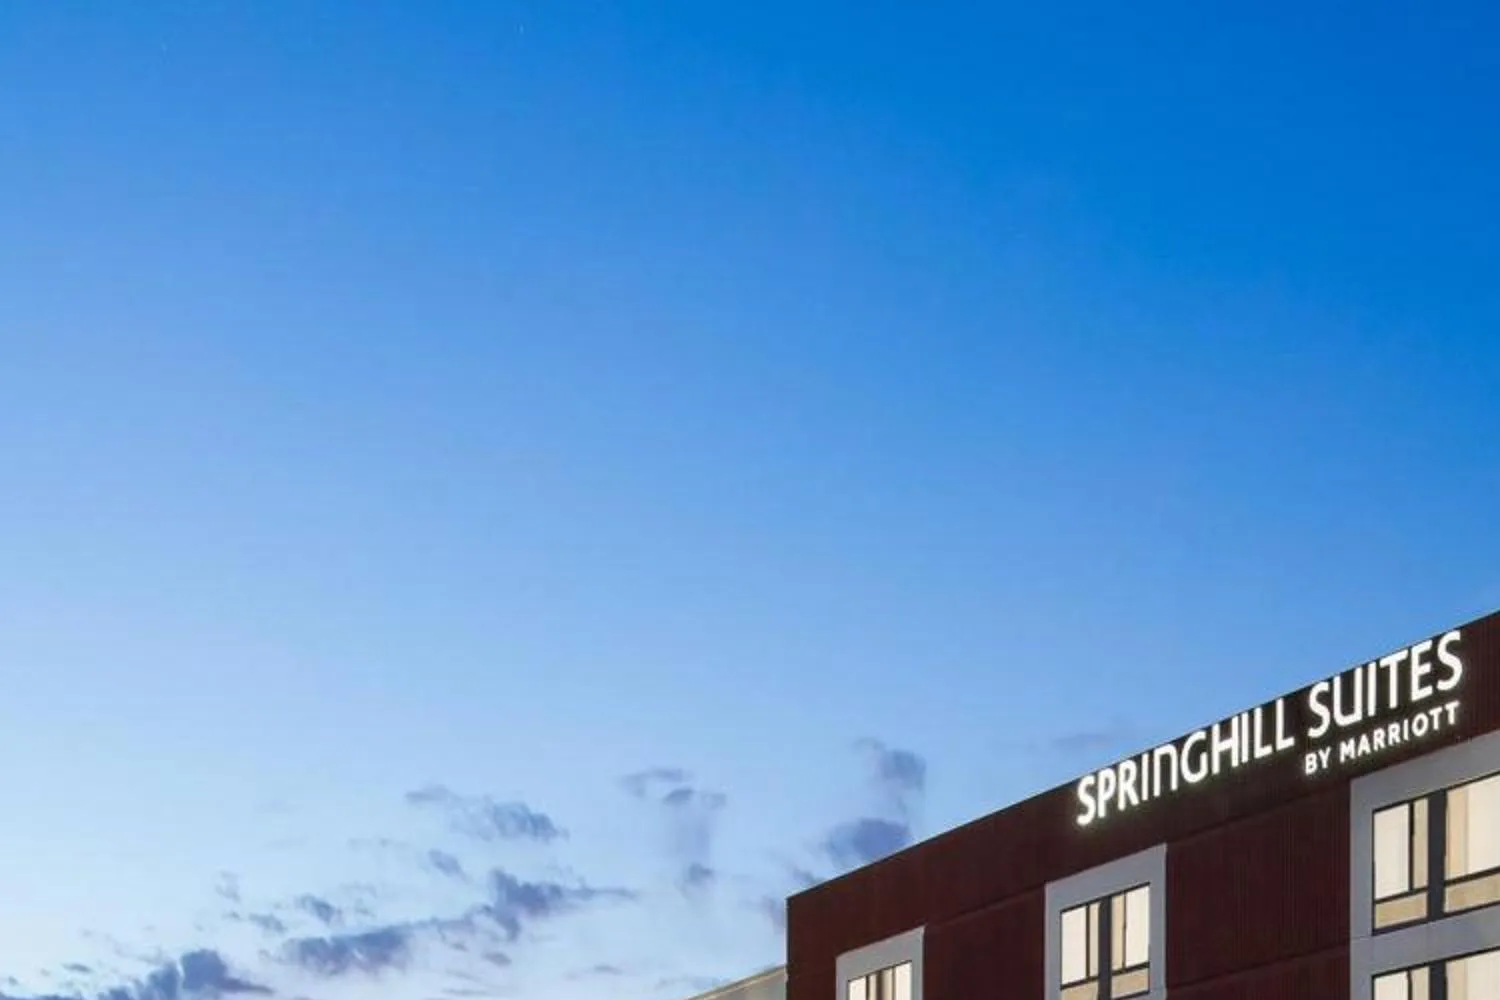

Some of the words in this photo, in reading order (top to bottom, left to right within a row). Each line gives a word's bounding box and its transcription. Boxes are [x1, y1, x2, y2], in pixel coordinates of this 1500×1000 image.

[1076, 699, 1295, 827] SPRINGHILL
[1306, 630, 1463, 739] SUITES
[1304, 747, 1330, 776] BY
[1339, 701, 1461, 762] MARRIOTT
